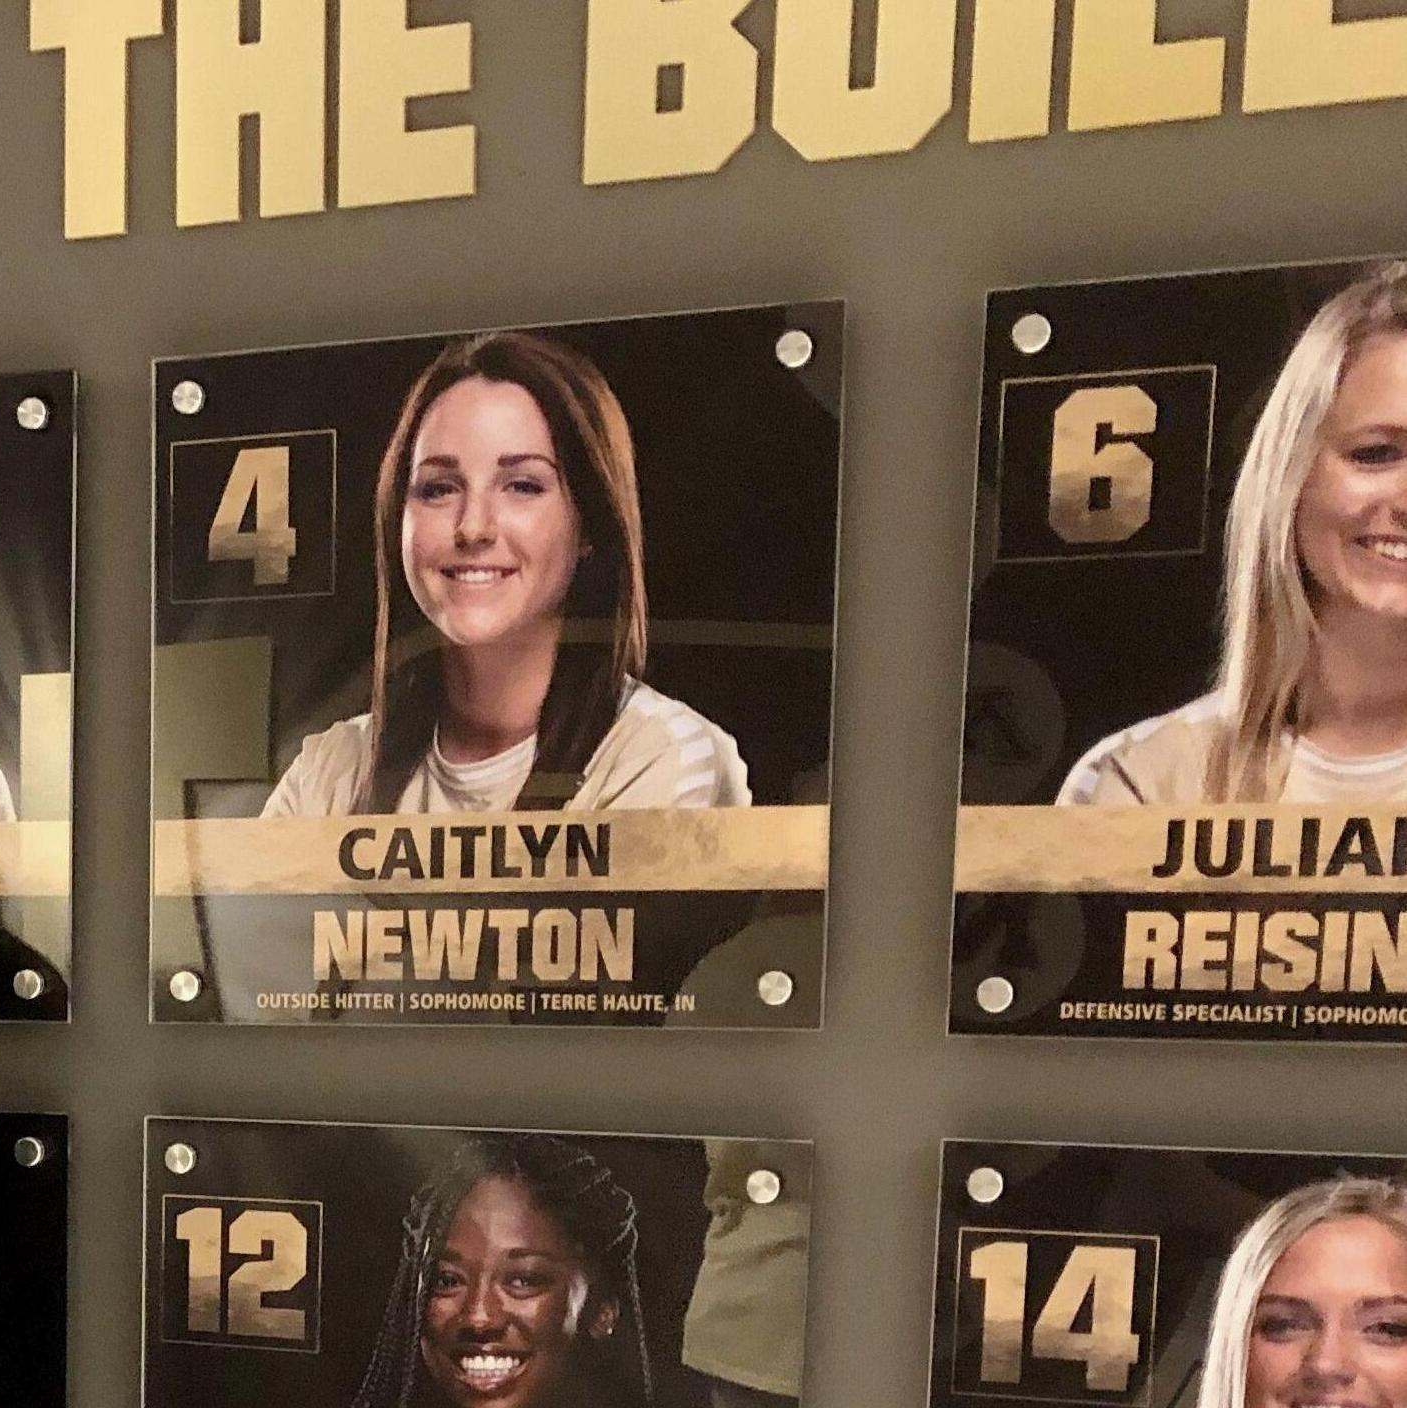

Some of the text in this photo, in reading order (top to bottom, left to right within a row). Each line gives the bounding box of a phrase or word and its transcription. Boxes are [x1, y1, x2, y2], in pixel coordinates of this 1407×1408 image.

[30, 0, 476, 240] THE
[208, 446, 296, 585] 4
[1048, 385, 1158, 544] 6
[338, 823, 611, 881] CAITLYN
[1152, 817, 1407, 878] JULIA
[313, 908, 635, 981] NEWTON
[256, 992, 695, 1013] OUTSIDE HITTER SOPHOMORE TERRE HAUTE, IN
[1059, 1001, 1167, 1021] DEFENSIVE
[1172, 1003, 1287, 1024] SPECIALIST
[176, 1206, 308, 1340] 12
[970, 1241, 1139, 1391] 14
